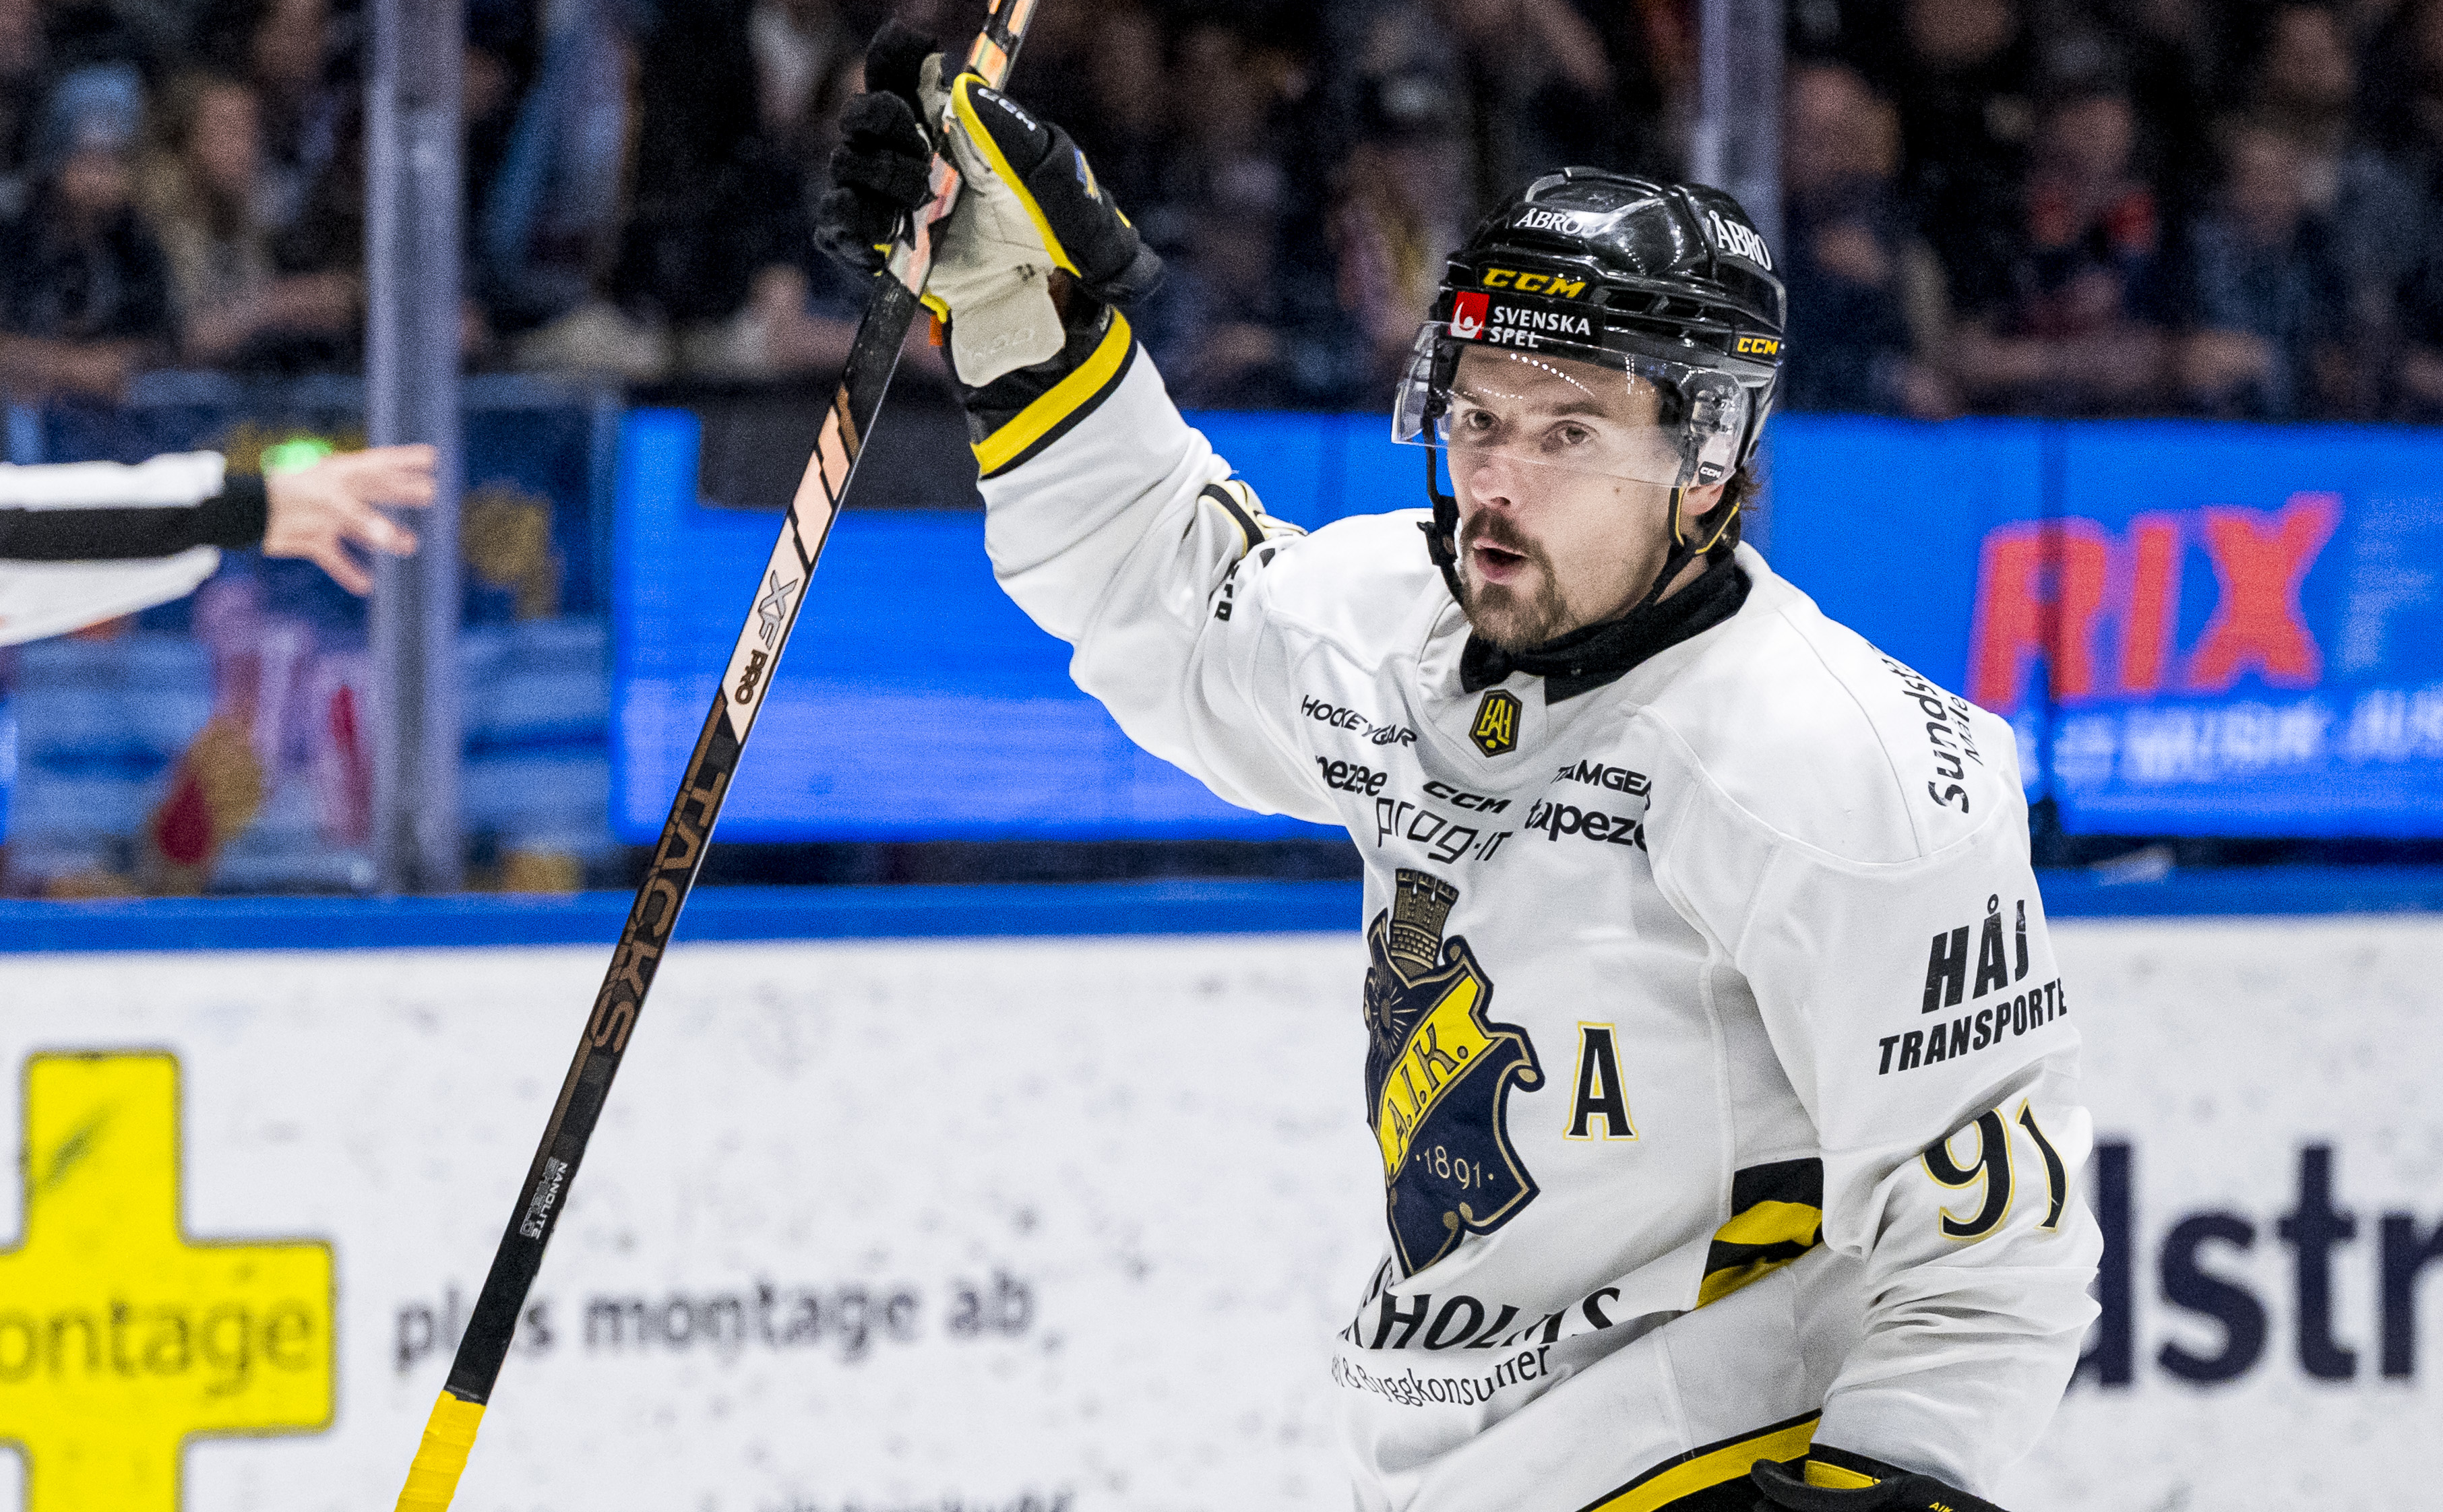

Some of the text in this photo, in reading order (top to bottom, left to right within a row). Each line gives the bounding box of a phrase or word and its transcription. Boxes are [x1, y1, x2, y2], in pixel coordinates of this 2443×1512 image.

[1514, 208, 1583, 234] ÅBRO
[1709, 210, 1772, 271] ÅBRO
[1483, 268, 1586, 298] CCM
[1489, 326, 1539, 348] SPEL
[1493, 306, 1590, 336] SVENSKA
[1737, 338, 1778, 354] CCM
[1700, 466, 1722, 478] CCM
[1968, 495, 2342, 714] RIX
[735, 649, 768, 705] PRO
[1423, 780, 1512, 814] CCM
[590, 771, 726, 1053] TACKS
[1921, 893, 2029, 1015] HÅJ
[1564, 1022, 1638, 1140] A
[1921, 1098, 2069, 1240] 91
[531, 1162, 567, 1240] NANOLITE
[395, 1284, 557, 1378] pls
[584, 1275, 921, 1366] montage
